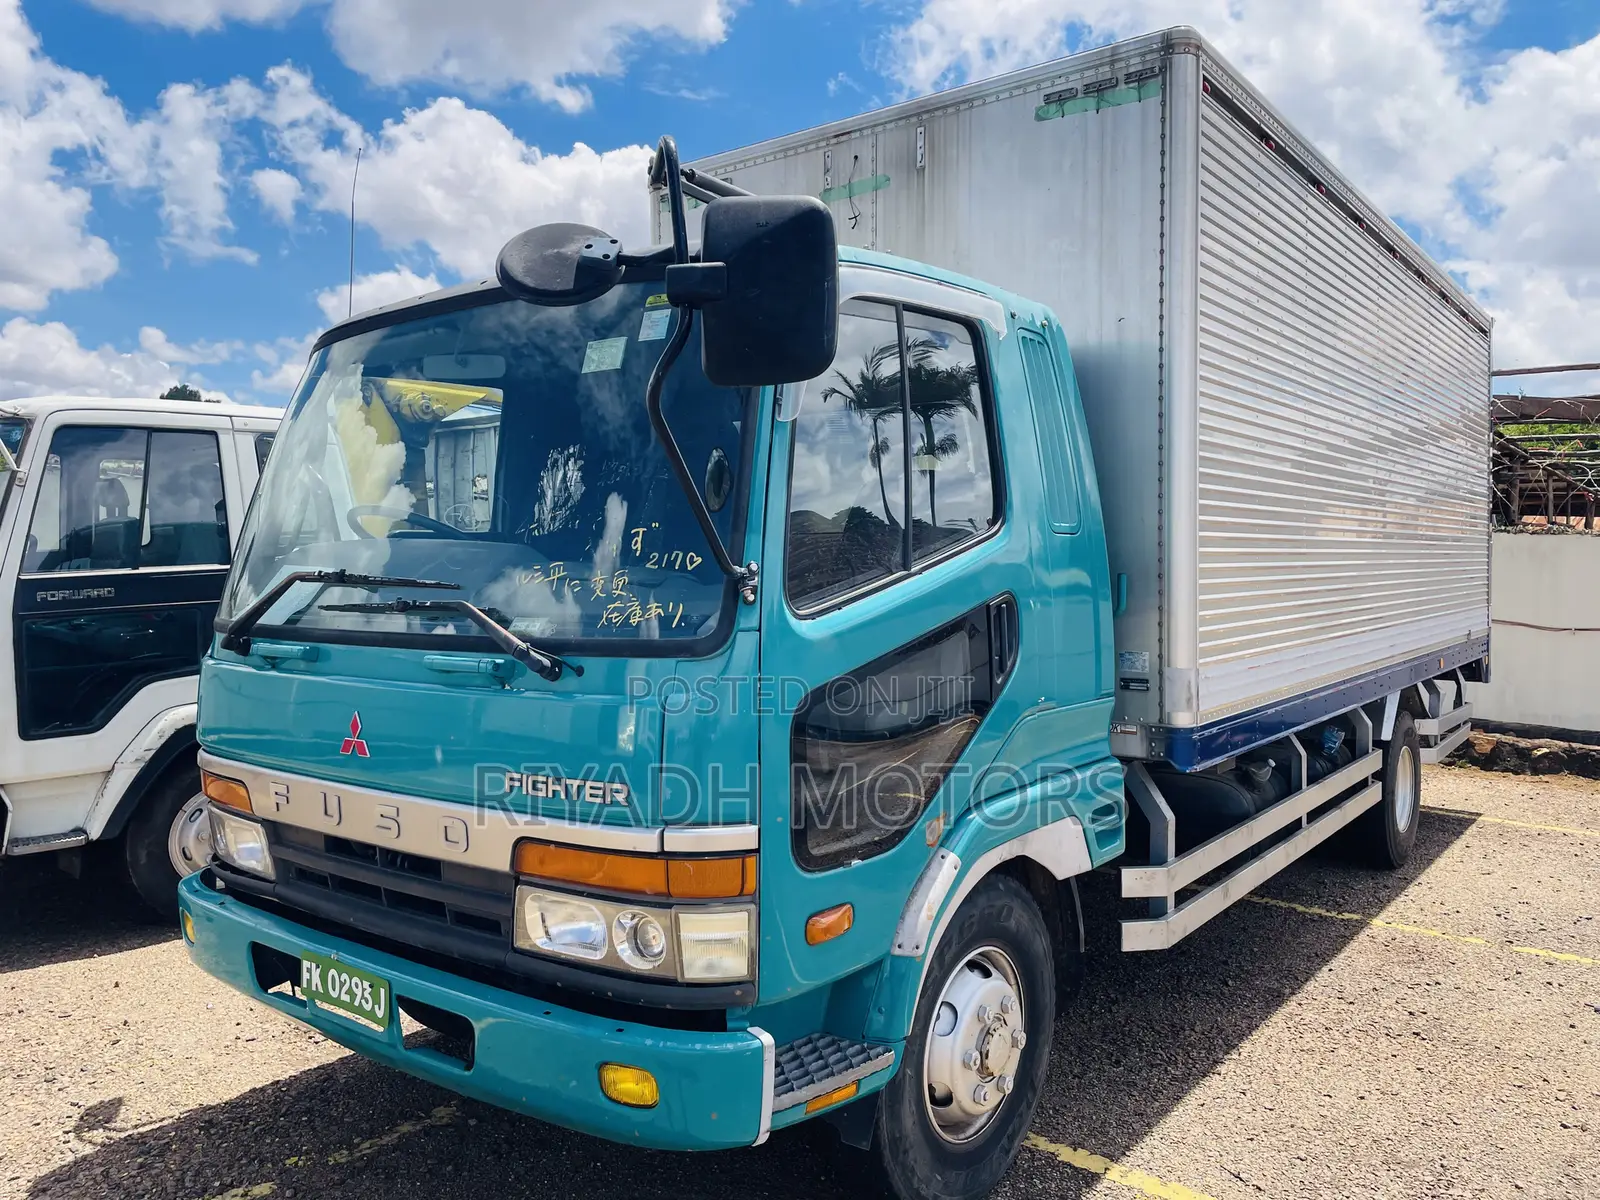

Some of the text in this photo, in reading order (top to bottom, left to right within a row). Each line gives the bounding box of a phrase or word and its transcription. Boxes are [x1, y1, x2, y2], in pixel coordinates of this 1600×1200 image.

[645, 551, 683, 570] 217
[36, 587, 115, 601] FORWARD
[504, 770, 630, 806] FIGHTER
[269, 781, 470, 854] FUSO
[302, 959, 386, 1018] FK 0293 J
